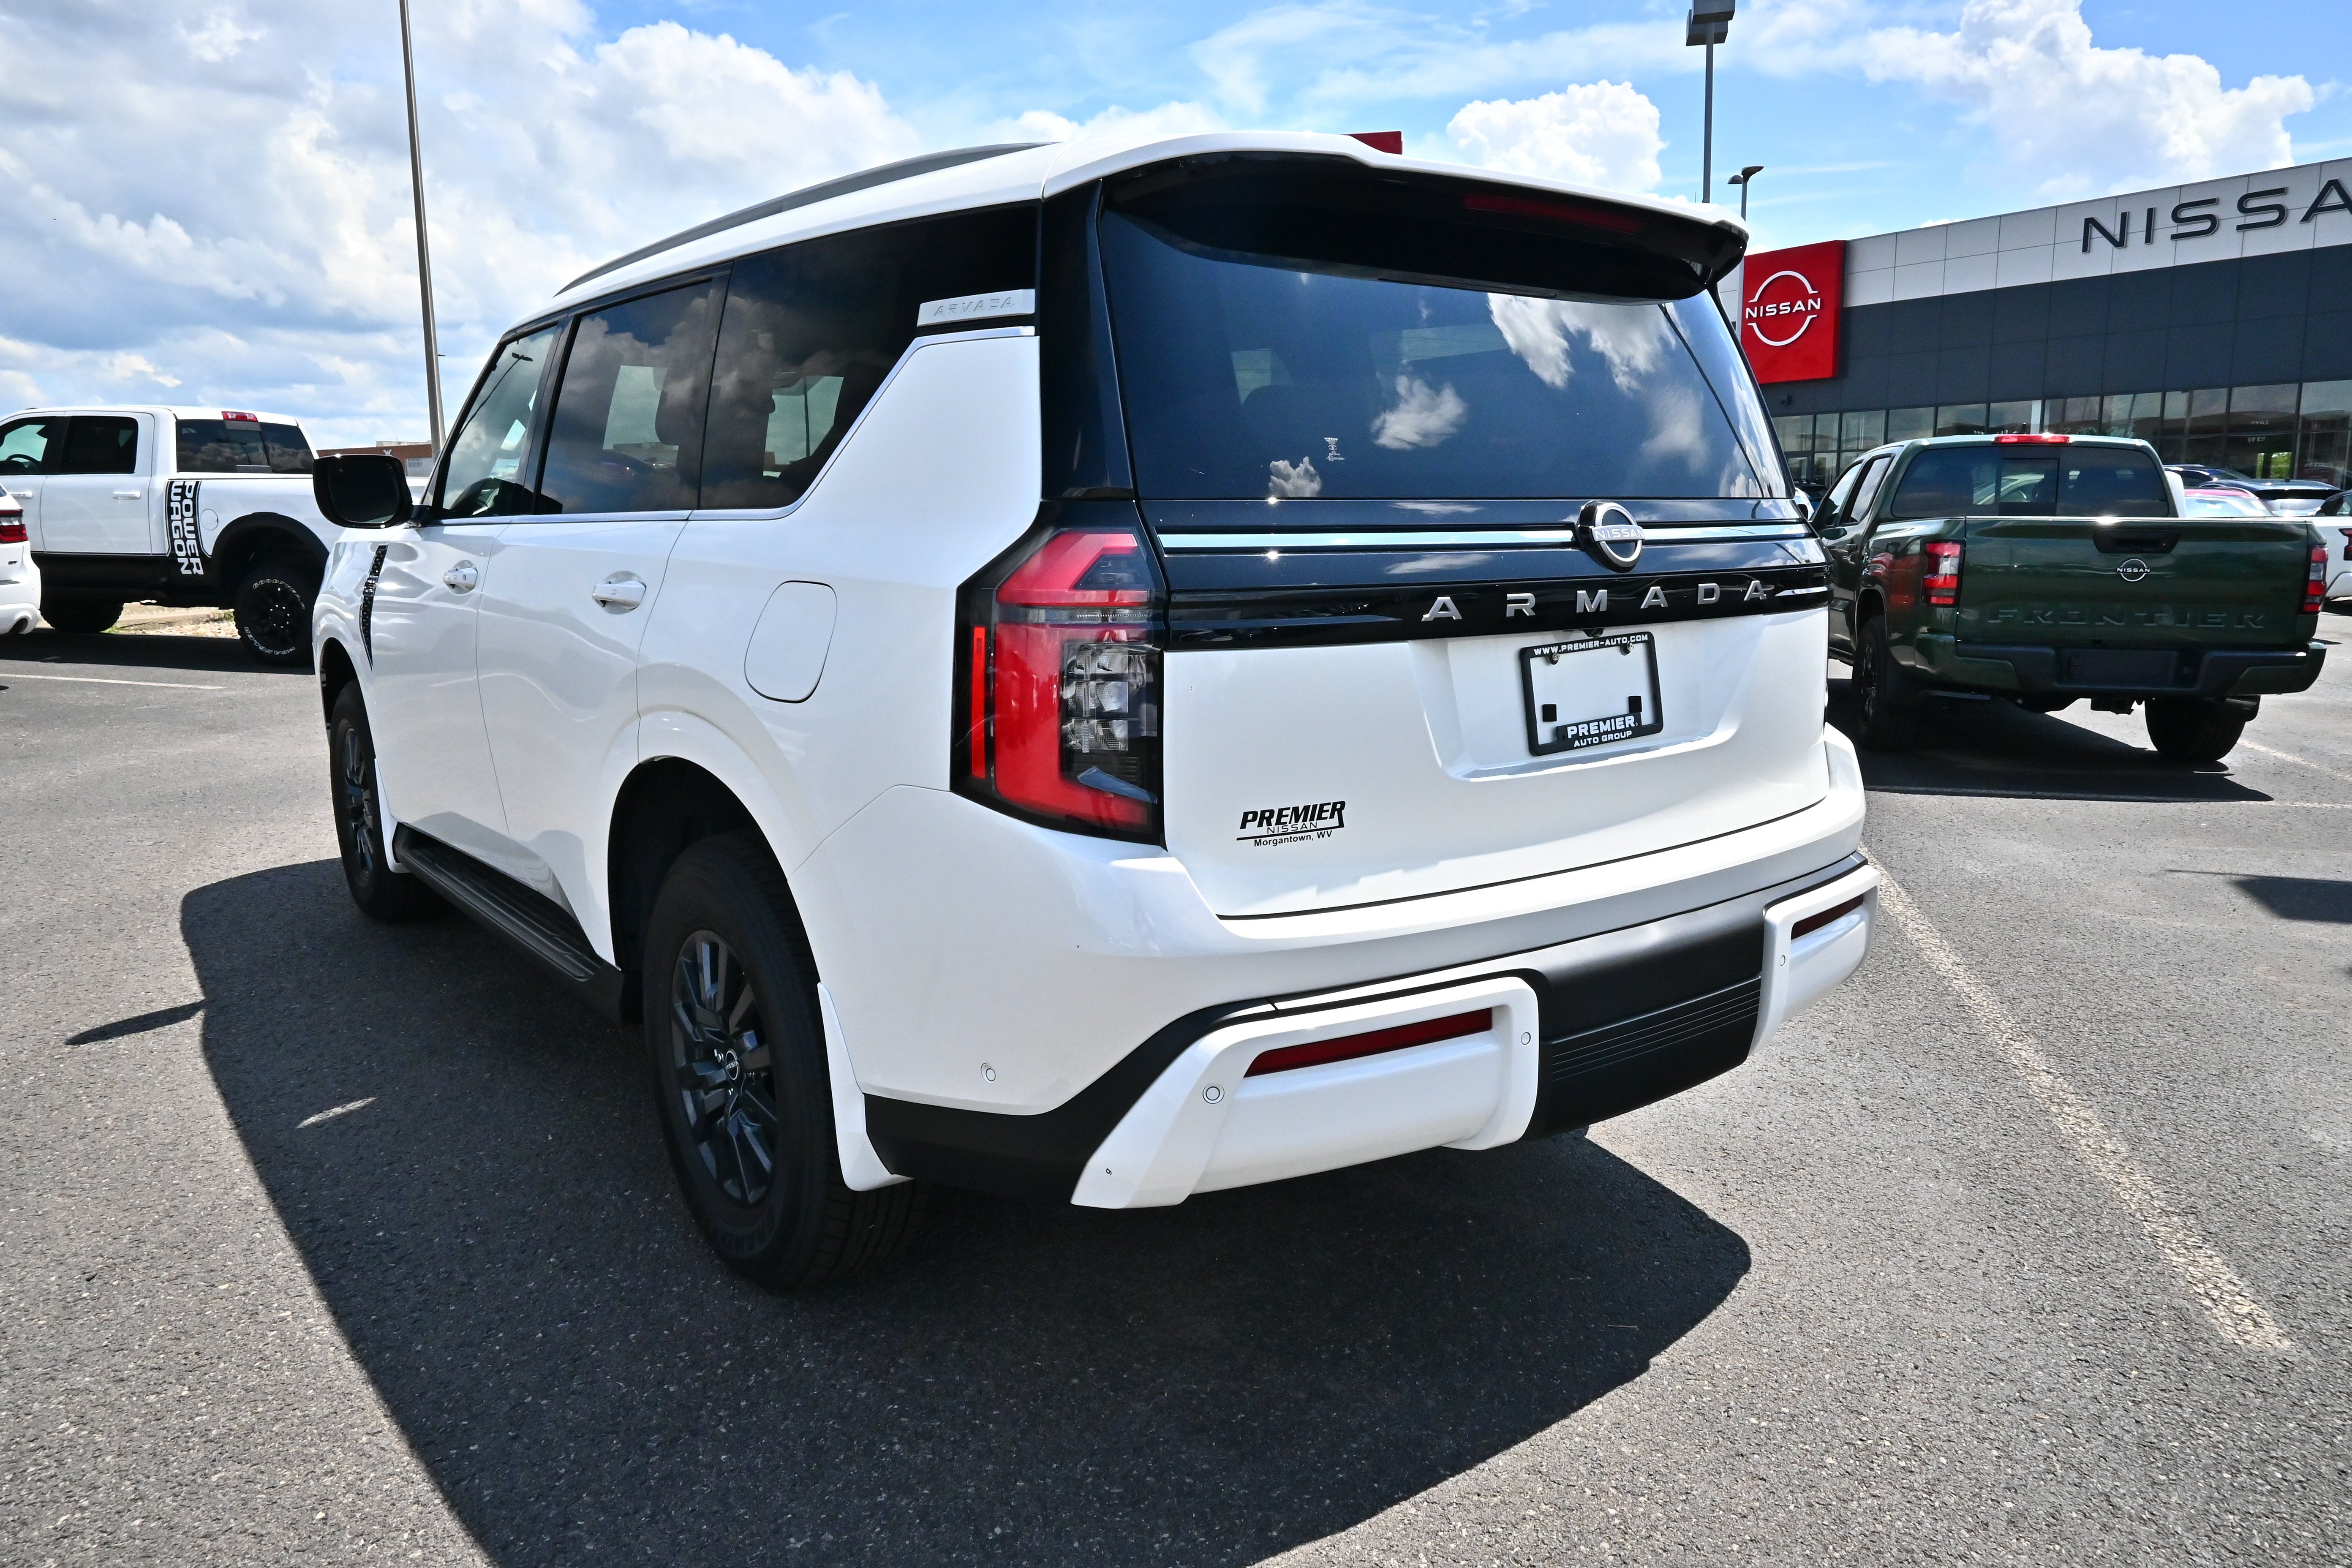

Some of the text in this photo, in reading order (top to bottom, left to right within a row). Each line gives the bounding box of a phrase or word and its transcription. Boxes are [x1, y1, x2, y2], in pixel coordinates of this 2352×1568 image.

[933, 297, 1014, 316] ARMADA
[1745, 297, 1821, 319] NISSAN
[170, 481, 193, 574] WAGON
[182, 481, 204, 575] POWER
[1594, 528, 1644, 540] NISSAN
[1421, 580, 1767, 622] ARMADA
[1987, 608, 2264, 629] FRONTIER
[1567, 715, 1635, 739] PREMIER
[1573, 730, 1632, 747] AUTO GROUP
[1240, 800, 1346, 830] PREMIER
[1254, 830, 1332, 847] Morgantown, WV
[1267, 822, 1318, 834] NISSAN
